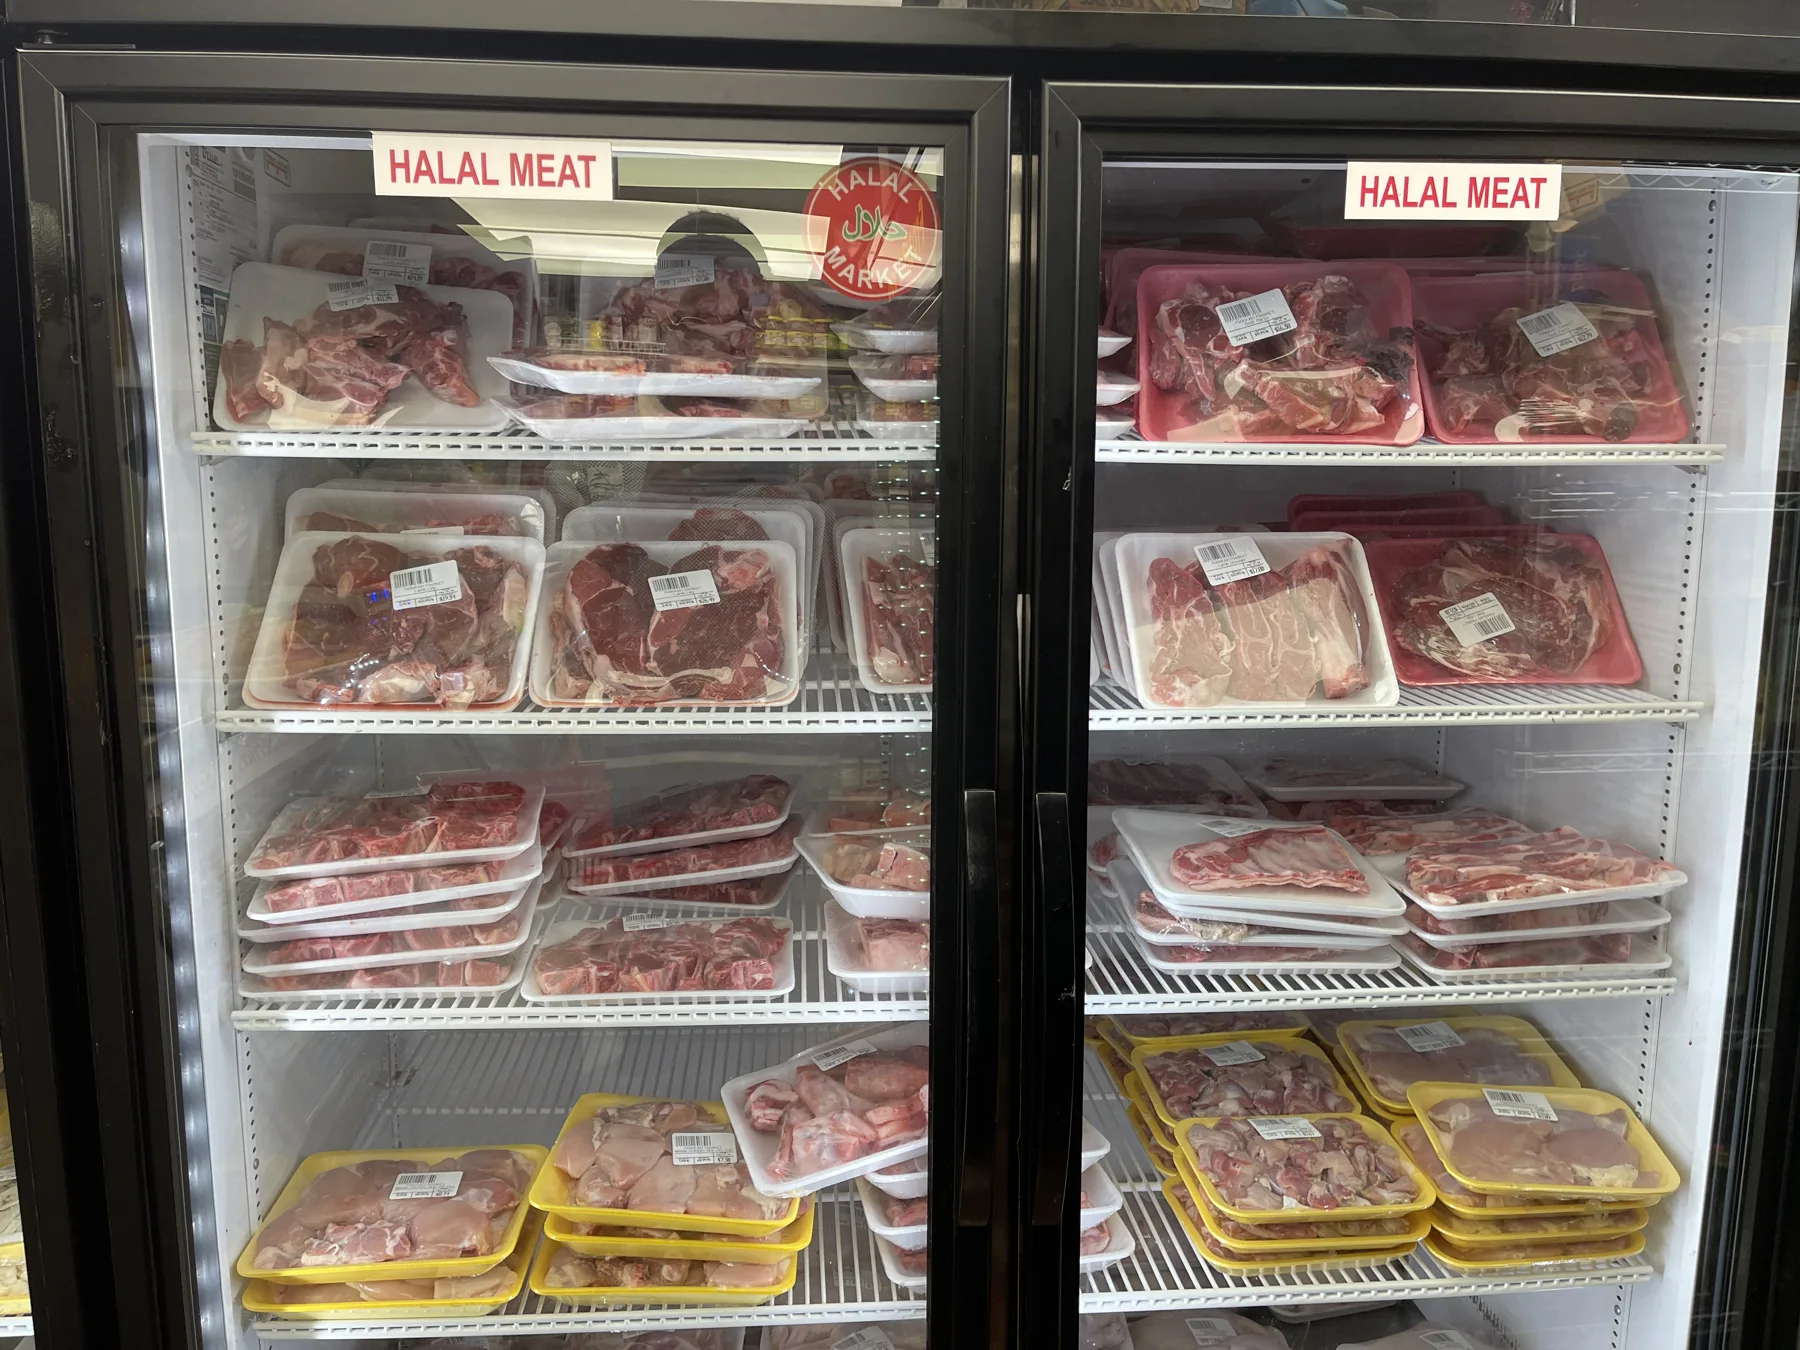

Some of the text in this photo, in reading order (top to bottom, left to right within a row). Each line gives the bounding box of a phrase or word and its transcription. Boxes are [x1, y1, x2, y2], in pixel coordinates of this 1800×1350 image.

[389, 149, 597, 188] HALAL MEAT
[828, 166, 912, 204] HALAL
[1360, 175, 1457, 208] HALAL
[1467, 177, 1547, 209] MEAT
[842, 204, 908, 242] حلال
[824, 245, 922, 289] MARKET
